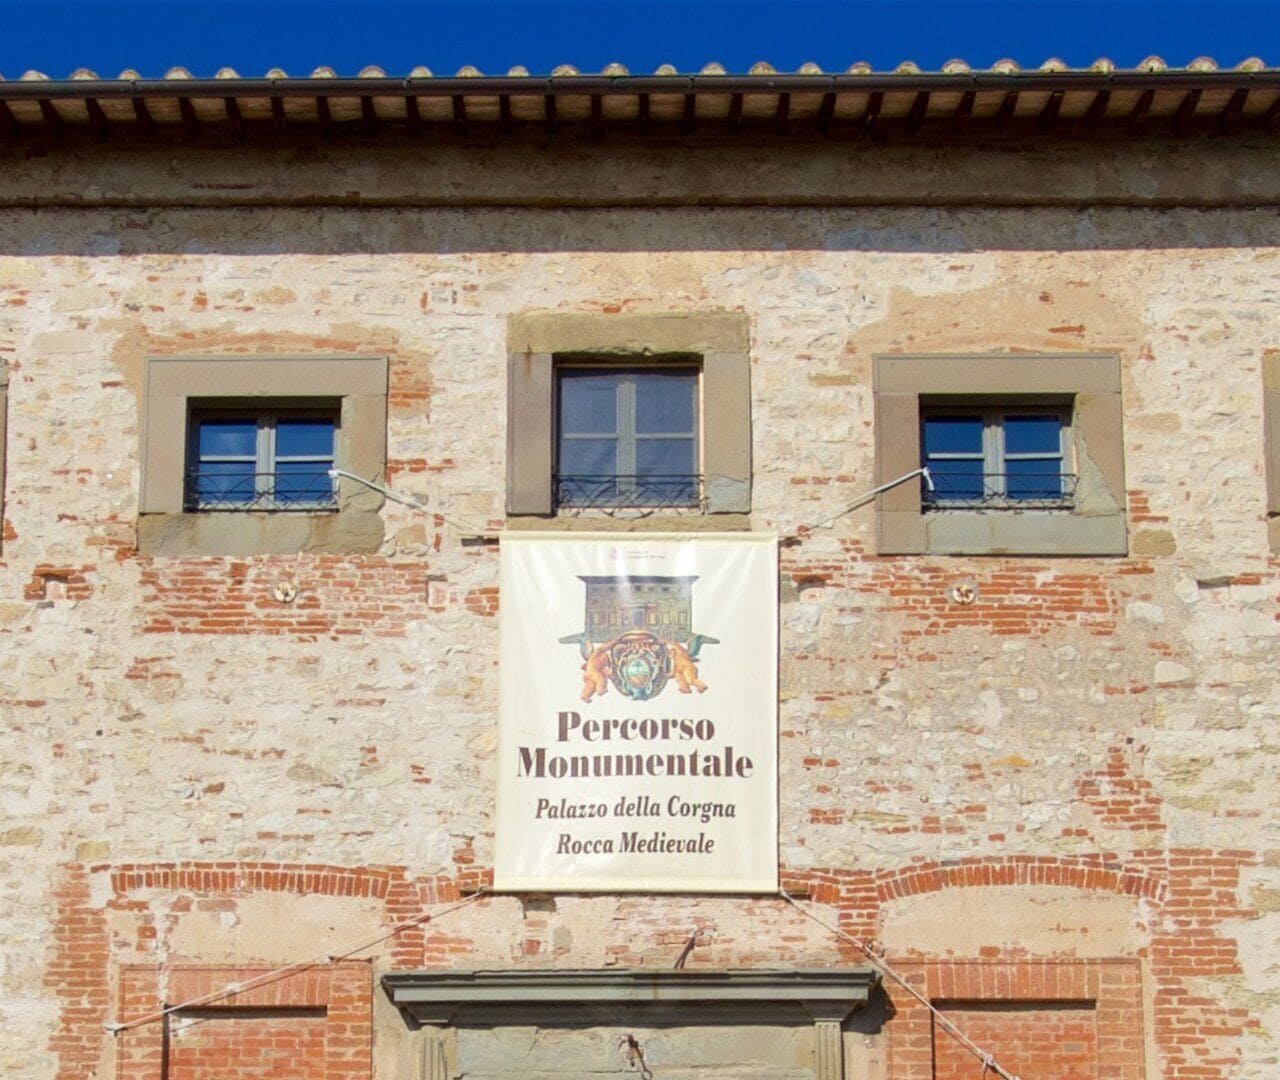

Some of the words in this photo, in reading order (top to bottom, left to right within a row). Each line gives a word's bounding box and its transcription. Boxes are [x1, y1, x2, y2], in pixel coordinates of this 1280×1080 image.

[556, 711, 715, 741] Percorso
[517, 746, 753, 778] Monumentale
[535, 798, 607, 819] Palazzo
[614, 796, 661, 817] della
[668, 795, 736, 823] Corgna
[556, 833, 614, 854] Rocca
[619, 832, 715, 853] Medievale
